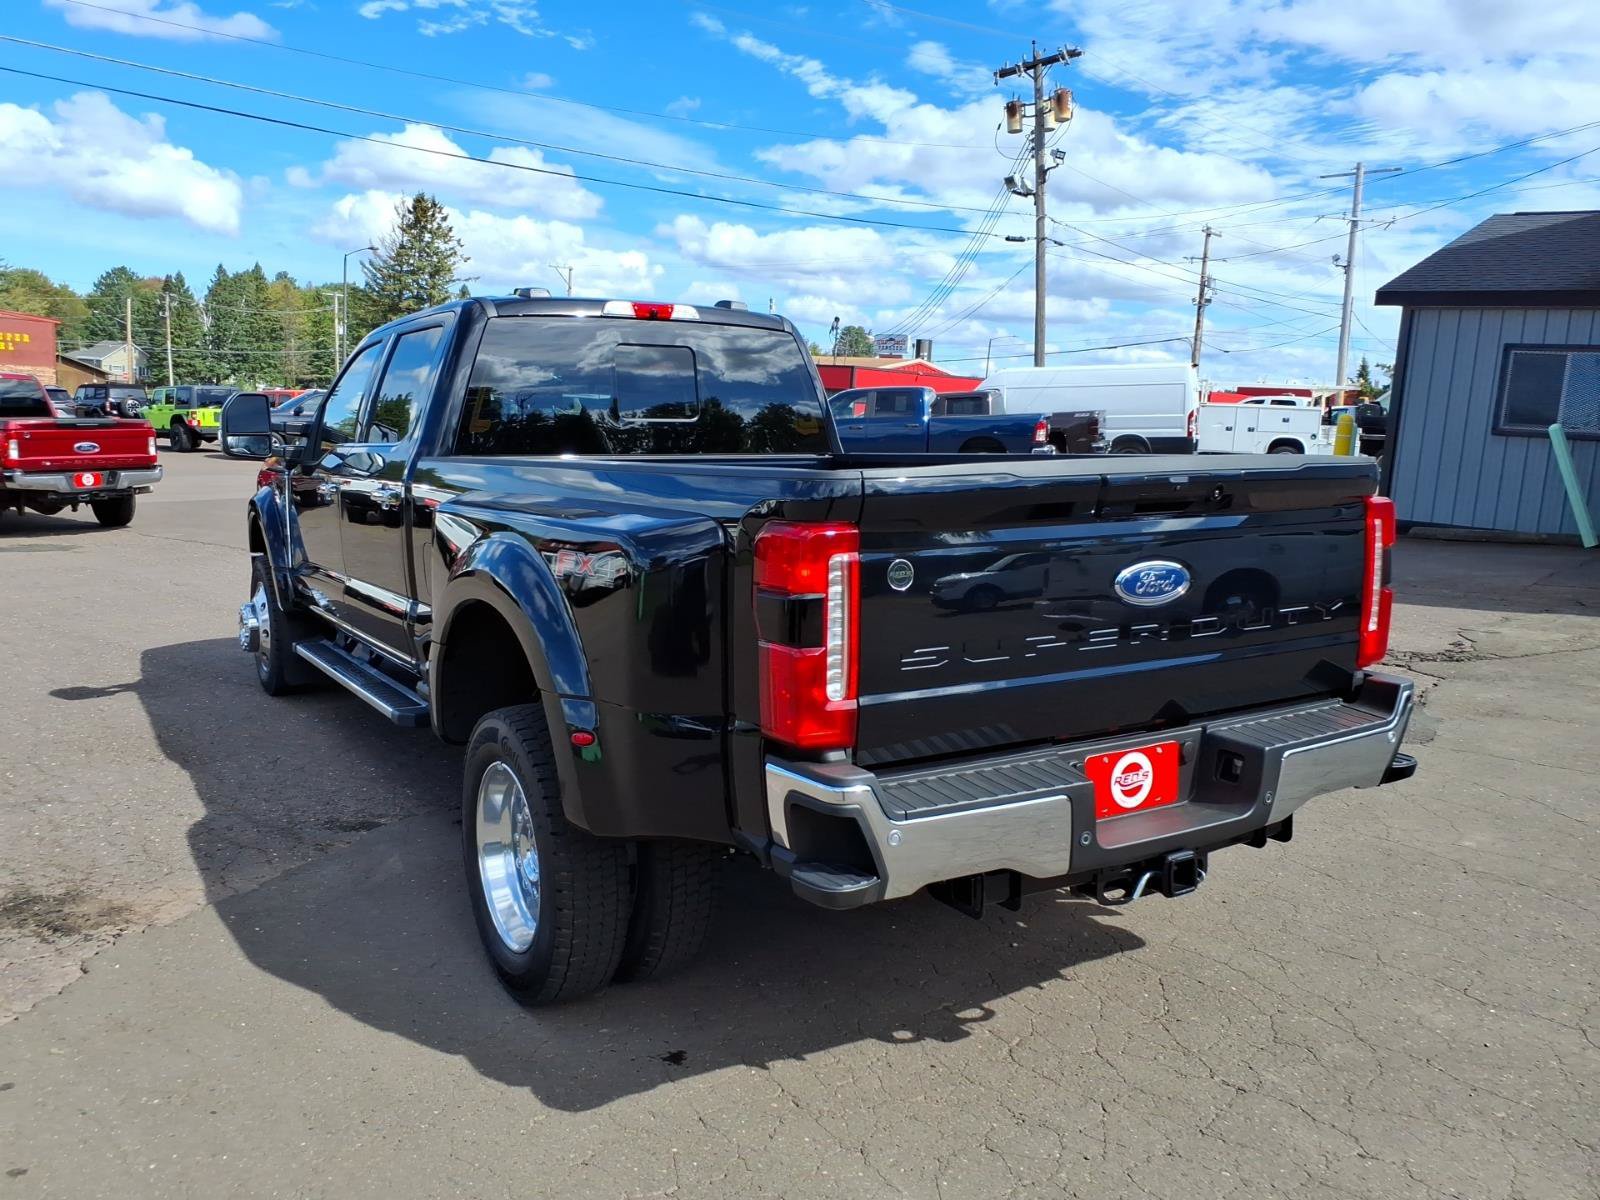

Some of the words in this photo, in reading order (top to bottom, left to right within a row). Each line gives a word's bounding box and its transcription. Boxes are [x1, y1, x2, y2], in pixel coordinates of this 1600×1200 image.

[555, 549, 617, 582] FX4
[1135, 570, 1176, 595] Ford
[900, 624, 1169, 671] SUPER
[1190, 599, 1344, 638] DUTY
